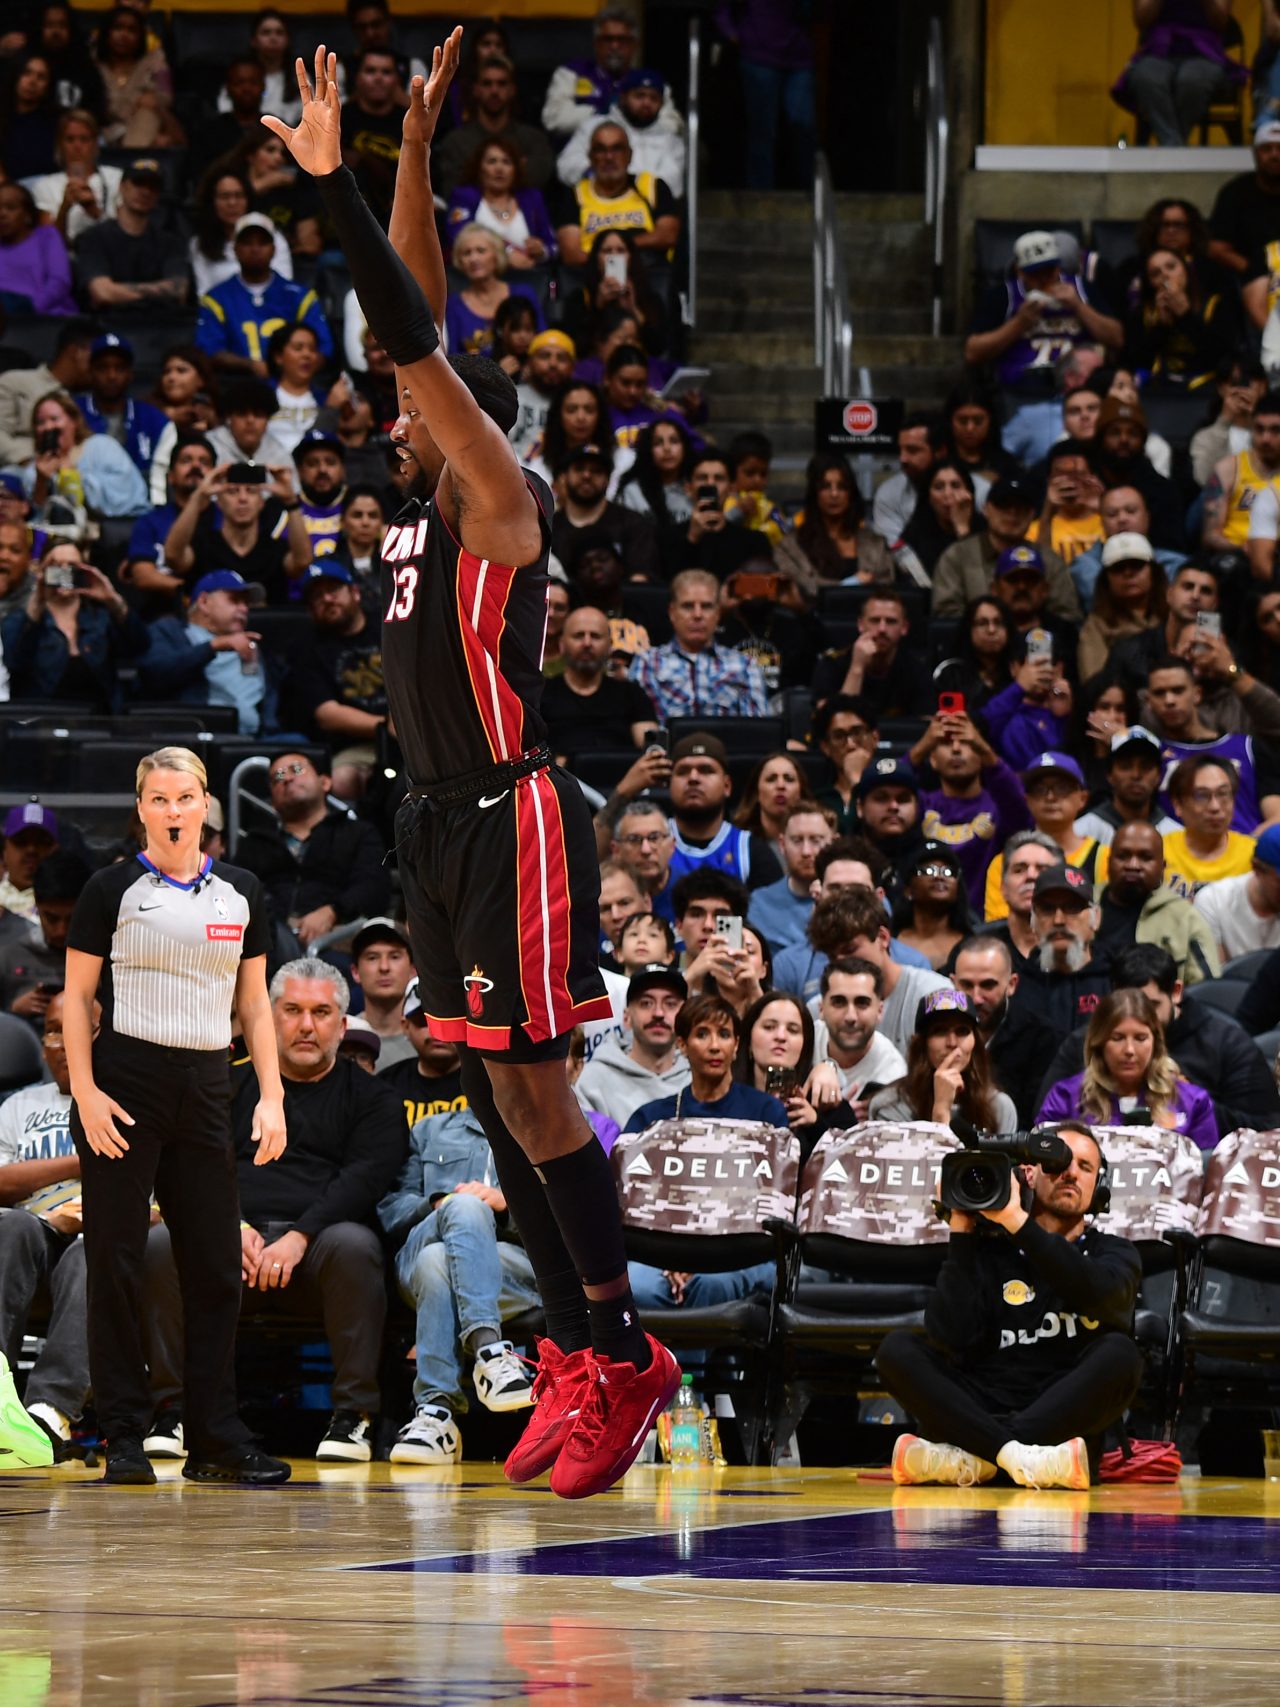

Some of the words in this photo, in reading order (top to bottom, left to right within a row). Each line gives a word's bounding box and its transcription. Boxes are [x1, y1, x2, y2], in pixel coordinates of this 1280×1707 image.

[664, 1156, 773, 1179] DELTA
[860, 1163, 942, 1187] DELT
[1111, 1166, 1172, 1189] LTA
